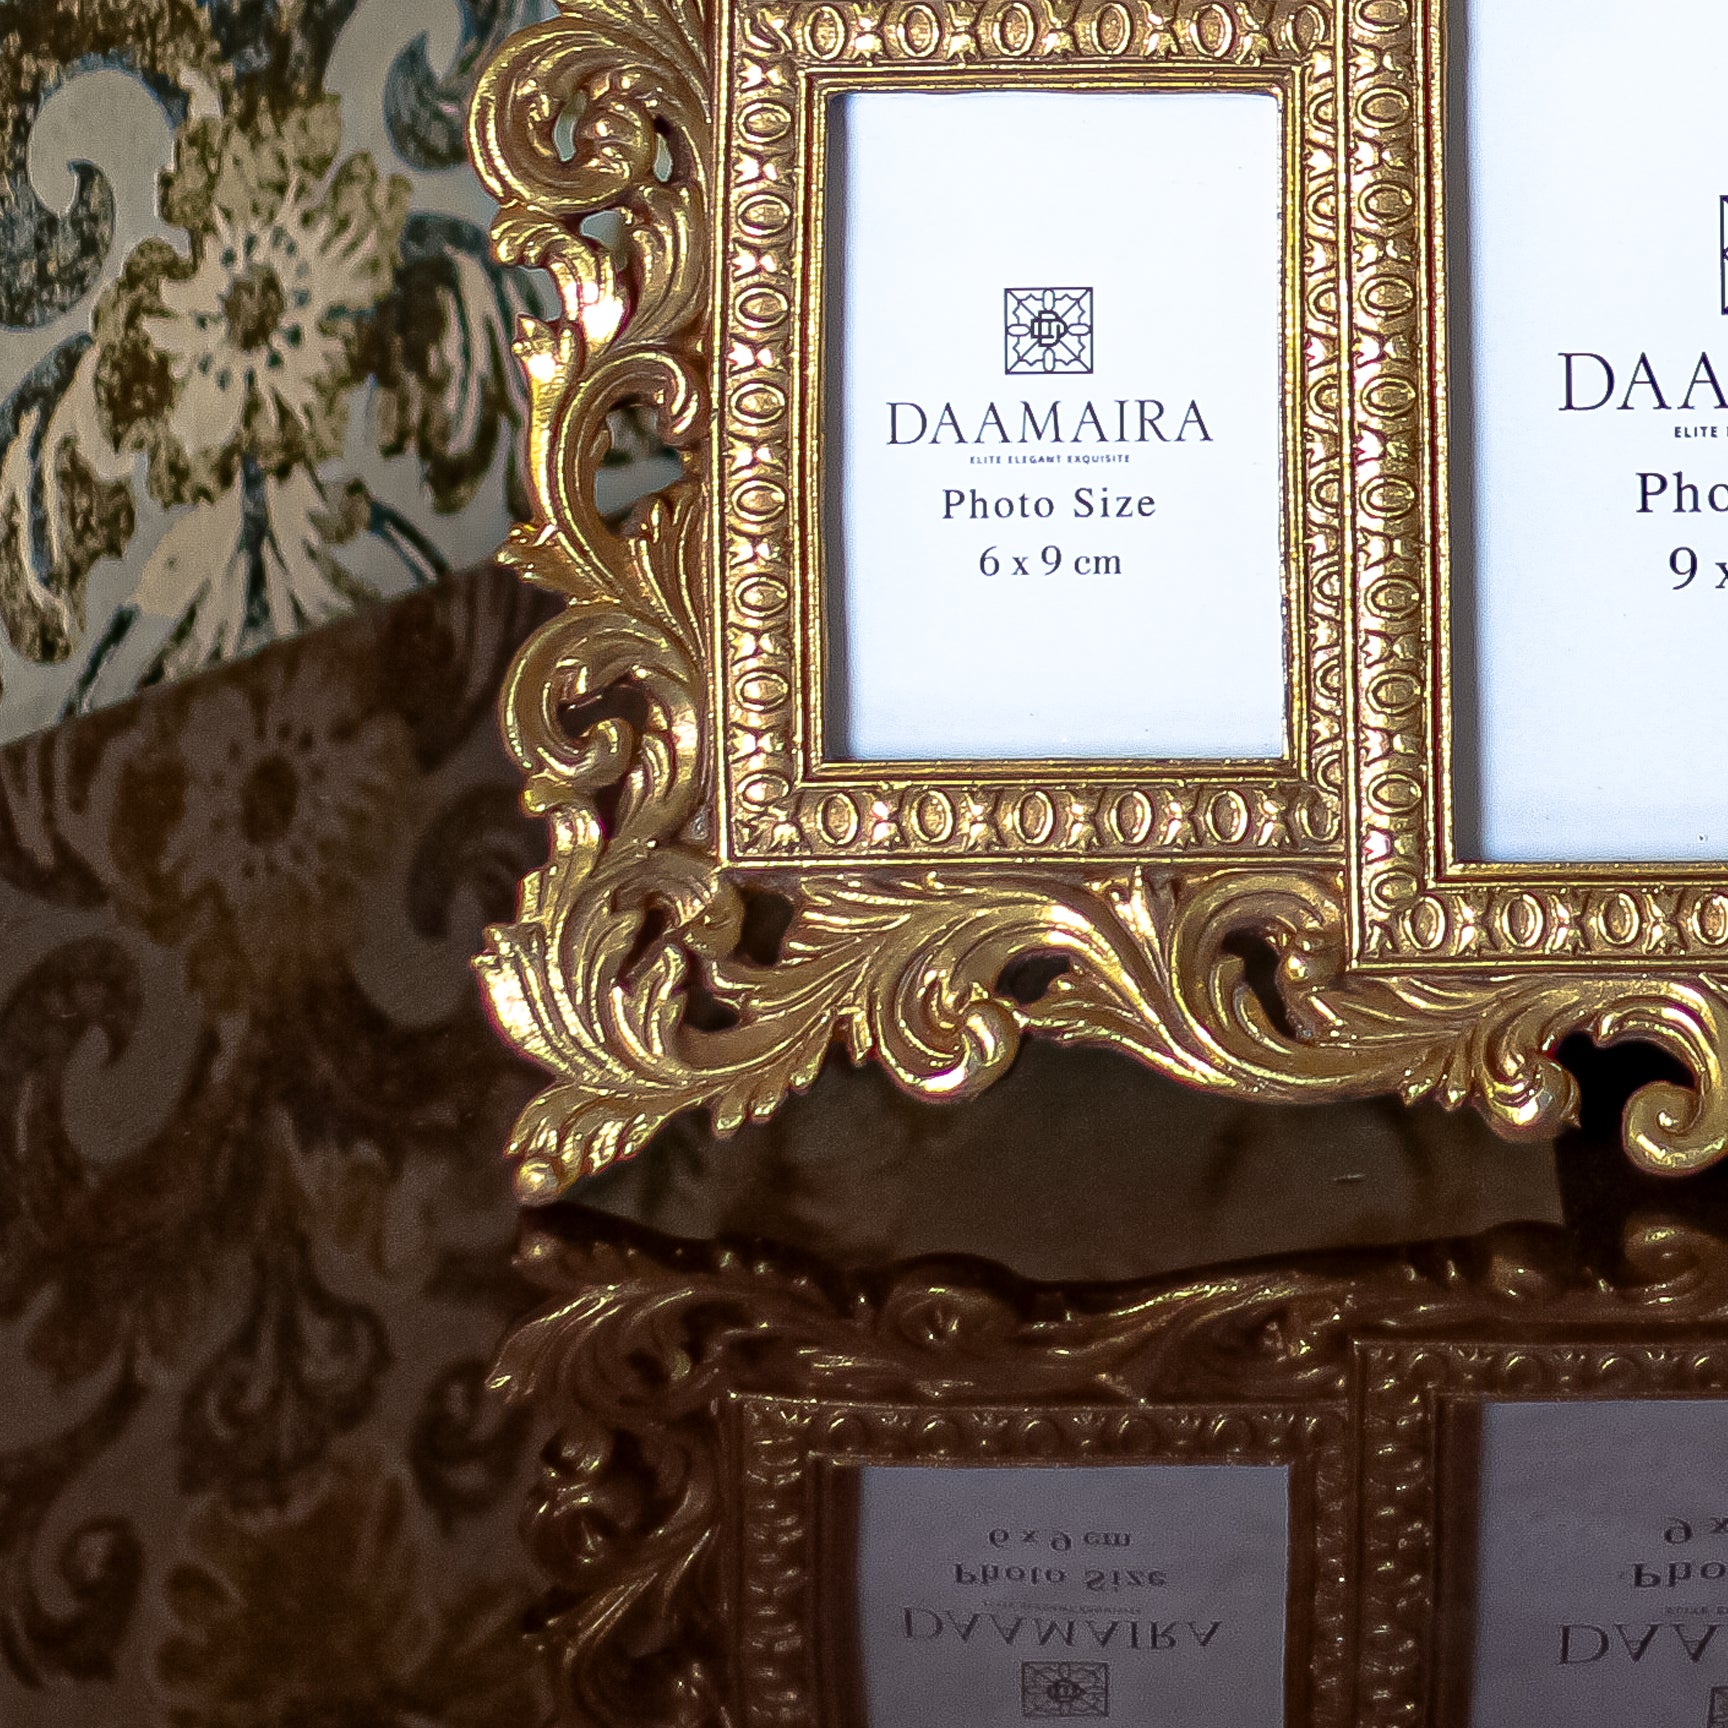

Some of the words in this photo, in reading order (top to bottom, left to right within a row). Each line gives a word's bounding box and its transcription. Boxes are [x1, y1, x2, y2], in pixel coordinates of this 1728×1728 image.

[886, 400, 1213, 445] DAAMAIRA
[1675, 426, 1717, 438] ELITE
[970, 456, 1000, 464] ELITE
[1008, 455, 1060, 464] ELEGANT
[1067, 455, 1129, 464] EXQUISITE
[943, 489, 1054, 519] Photo
[1074, 488, 1155, 517] Size
[980, 546, 999, 576] 6
[1012, 557, 1029, 575] x
[1041, 545, 1061, 575] 9
[1075, 556, 1121, 575] cm
[1670, 547, 1697, 590] 9
